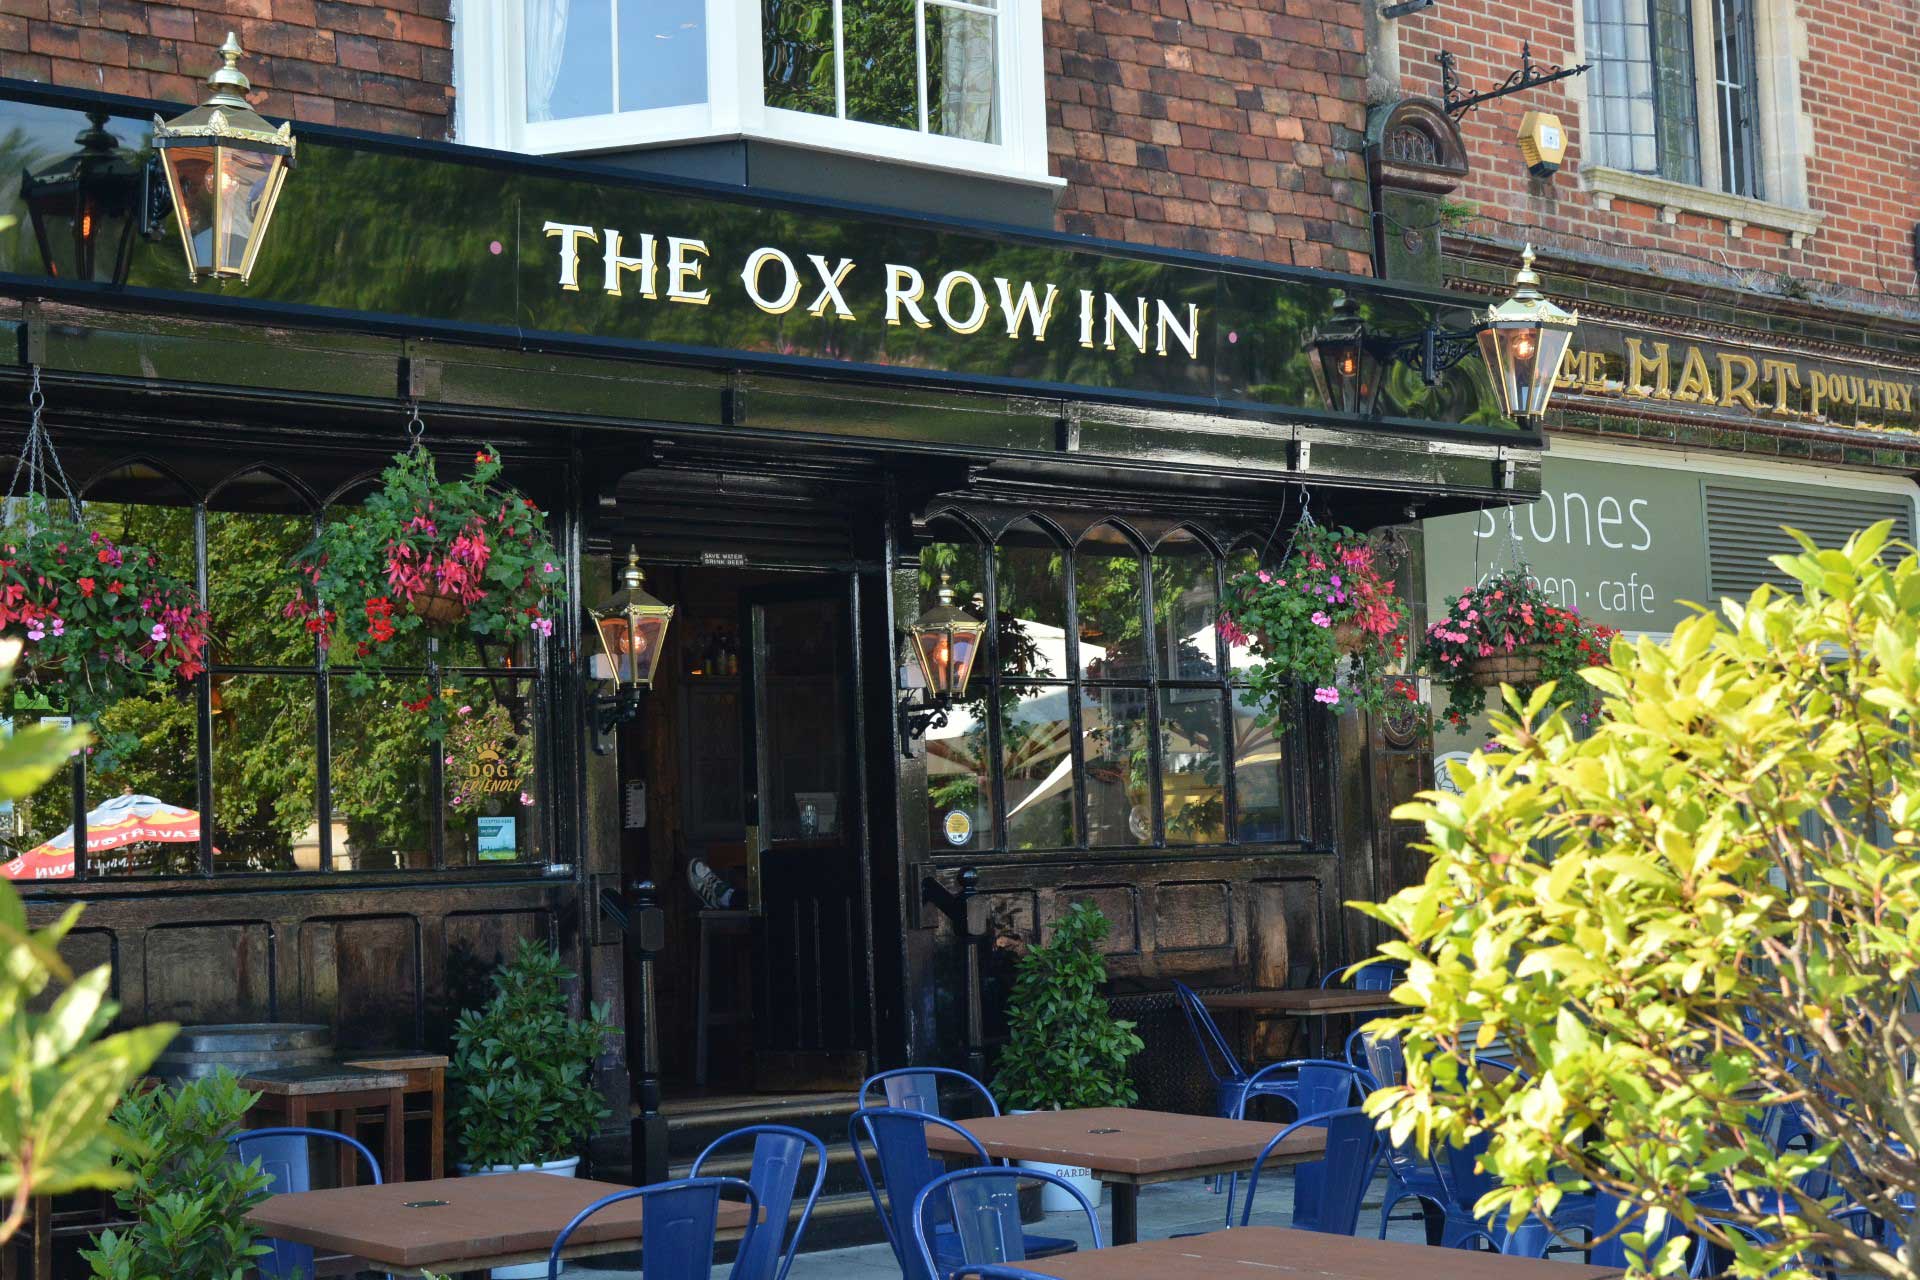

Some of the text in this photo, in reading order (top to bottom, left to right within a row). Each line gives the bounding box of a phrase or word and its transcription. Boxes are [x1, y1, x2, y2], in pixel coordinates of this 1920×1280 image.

[543, 221, 1200, 360] THE OX ROW INN
[1558, 348, 1607, 386] ME
[1808, 369, 1914, 417] POULTRY
[1598, 573, 1655, 614] cafe
[461, 779, 522, 793] FRIENDLY
[469, 763, 508, 777] DOG
